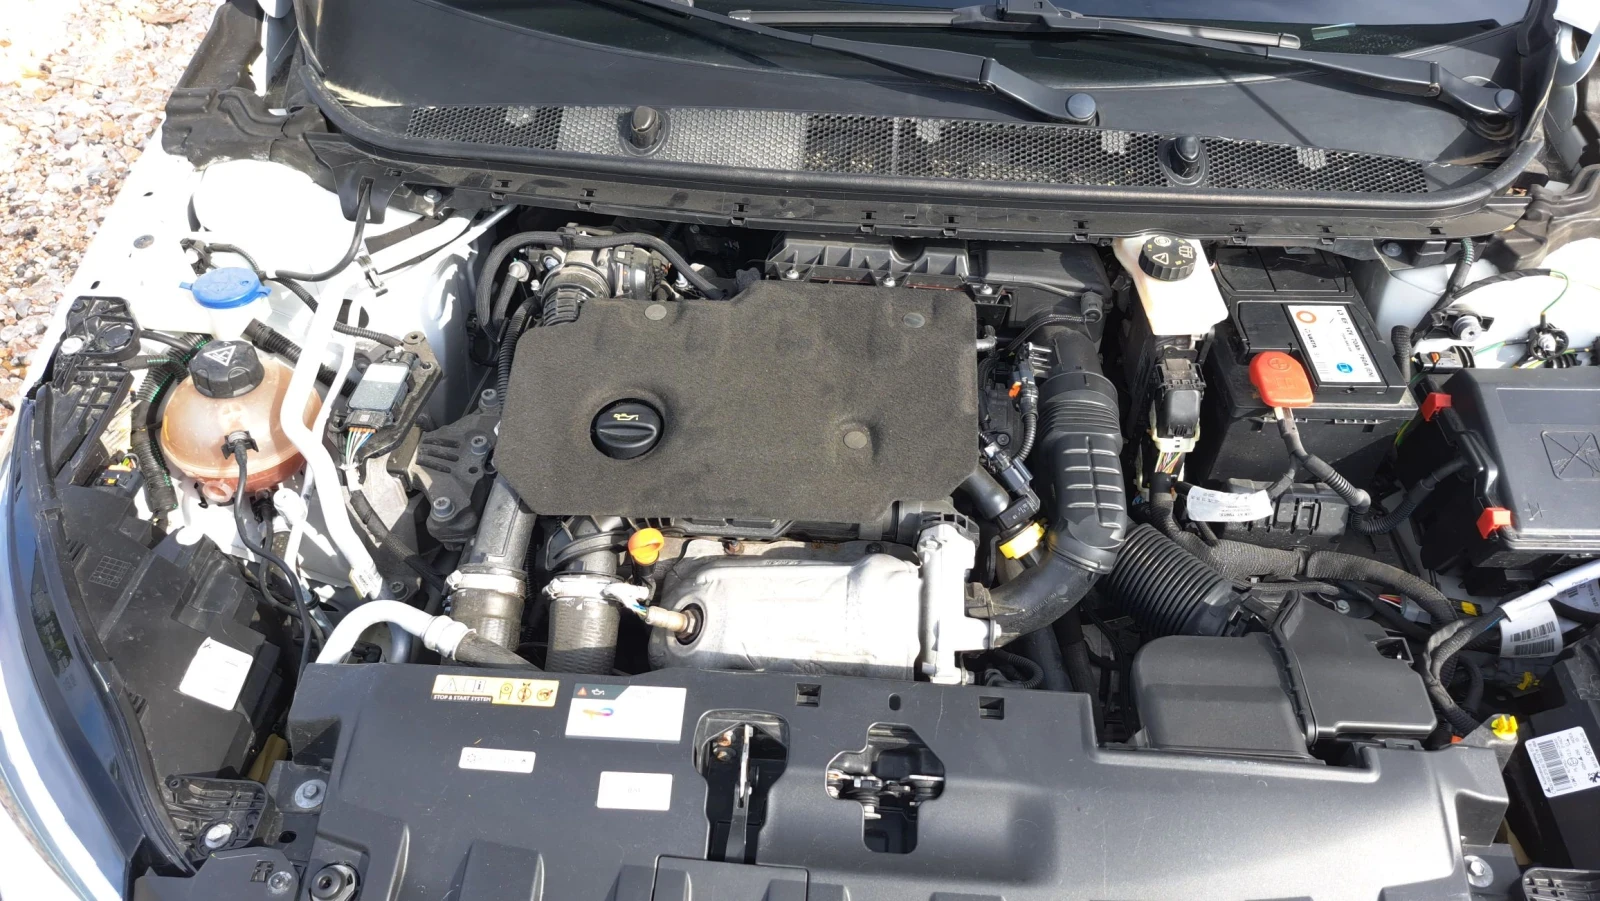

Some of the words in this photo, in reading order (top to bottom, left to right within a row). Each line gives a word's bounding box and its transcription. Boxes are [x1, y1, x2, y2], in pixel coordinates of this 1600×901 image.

[1307, 333, 1318, 349] VARTA
[1345, 326, 1355, 336] 12V
[1351, 338, 1361, 351] 70Ah
